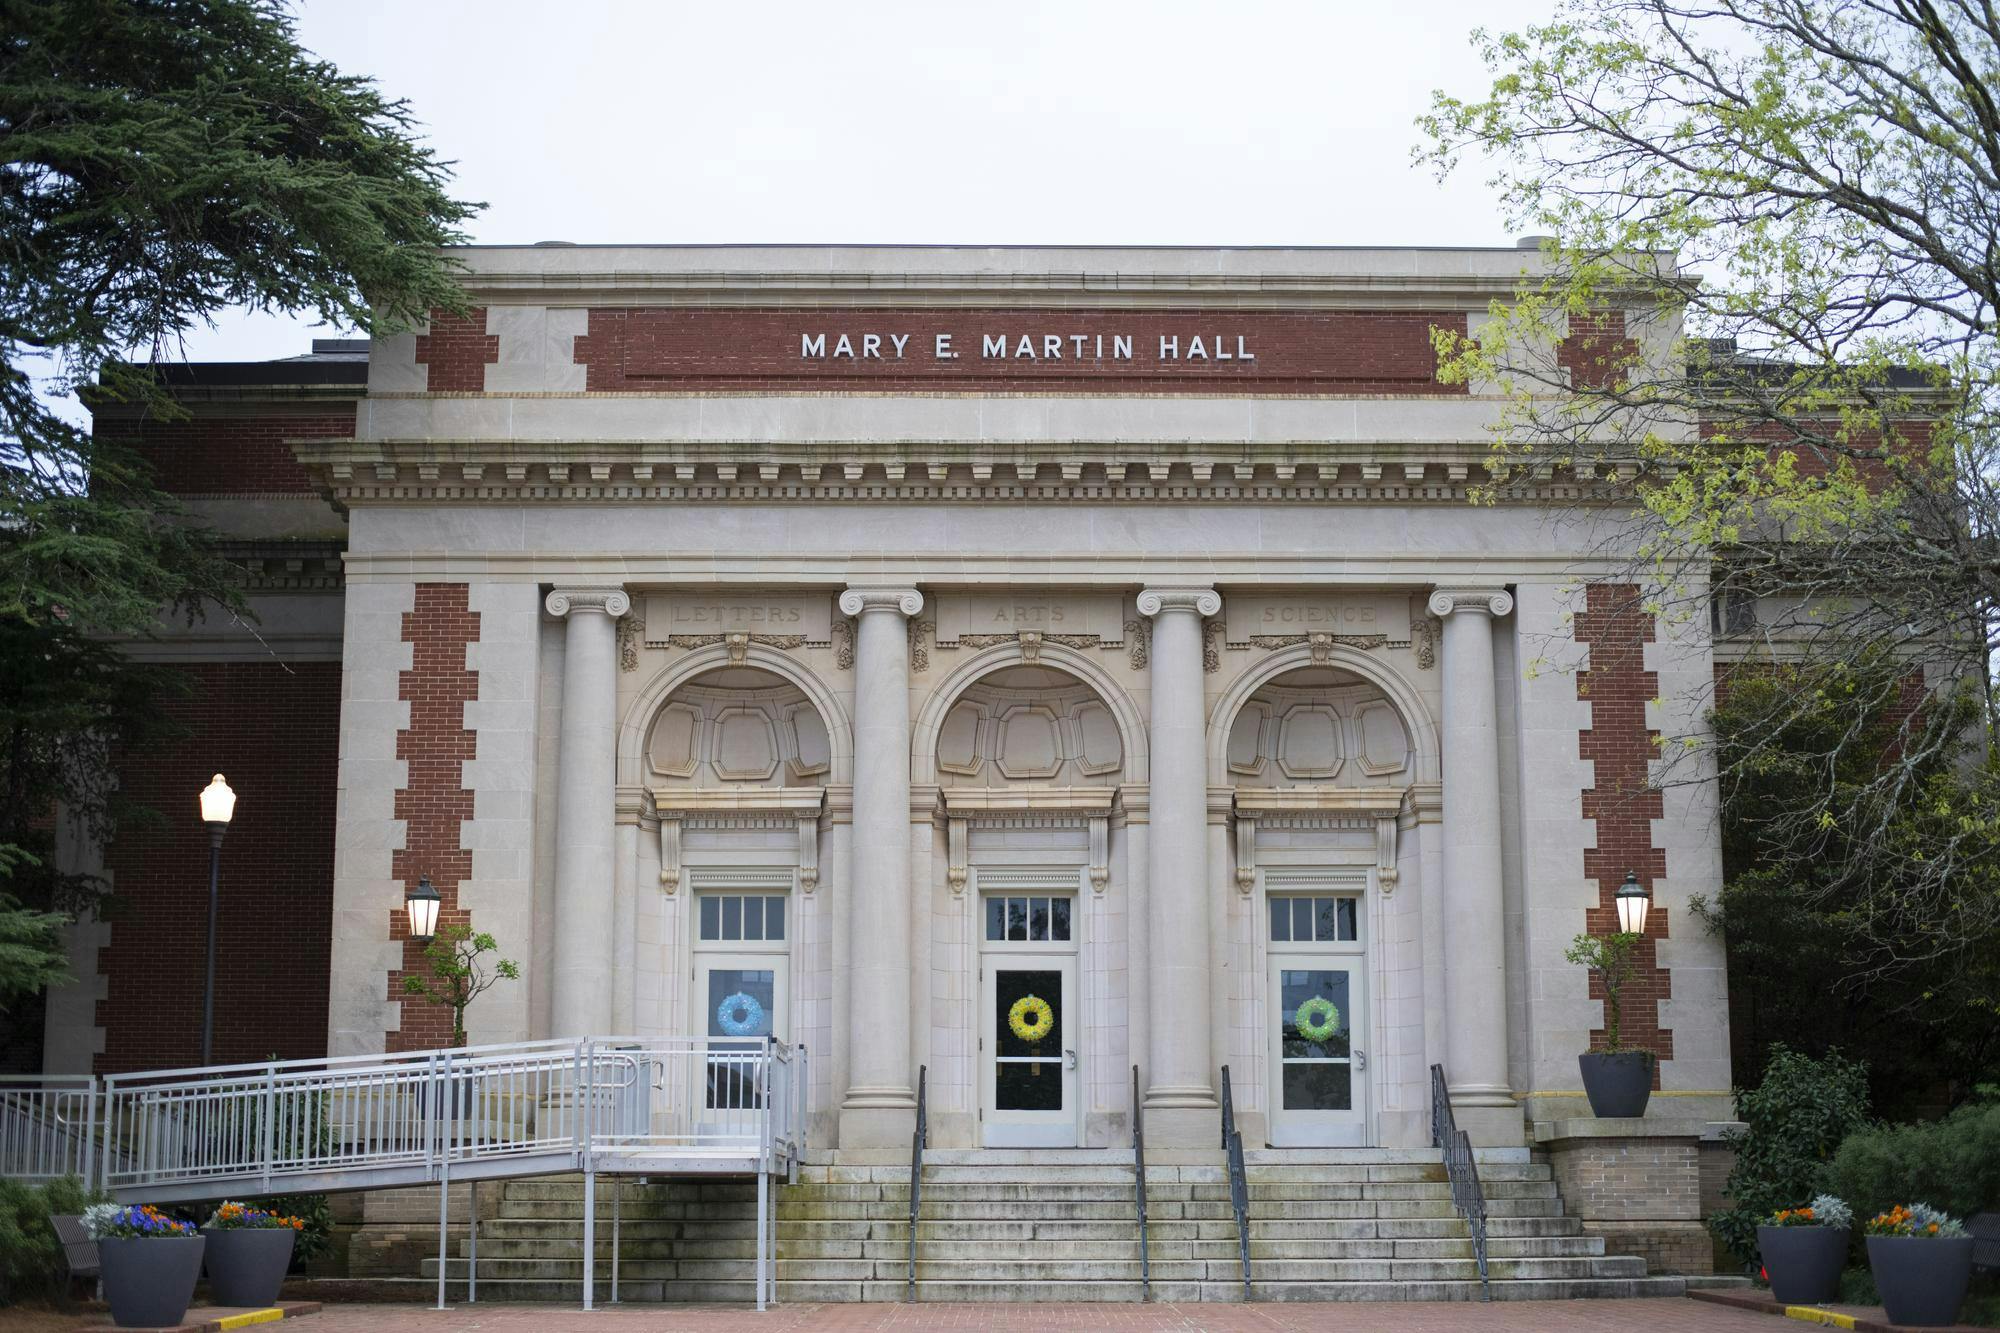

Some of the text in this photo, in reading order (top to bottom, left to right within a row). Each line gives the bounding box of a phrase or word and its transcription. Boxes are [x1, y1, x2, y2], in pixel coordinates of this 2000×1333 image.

[801, 333, 1256, 361] MARY E. MARTIN HALL
[674, 606, 801, 622] LETTERS
[994, 605, 1064, 622] ARTS
[1262, 606, 1374, 622] SCIENCE
